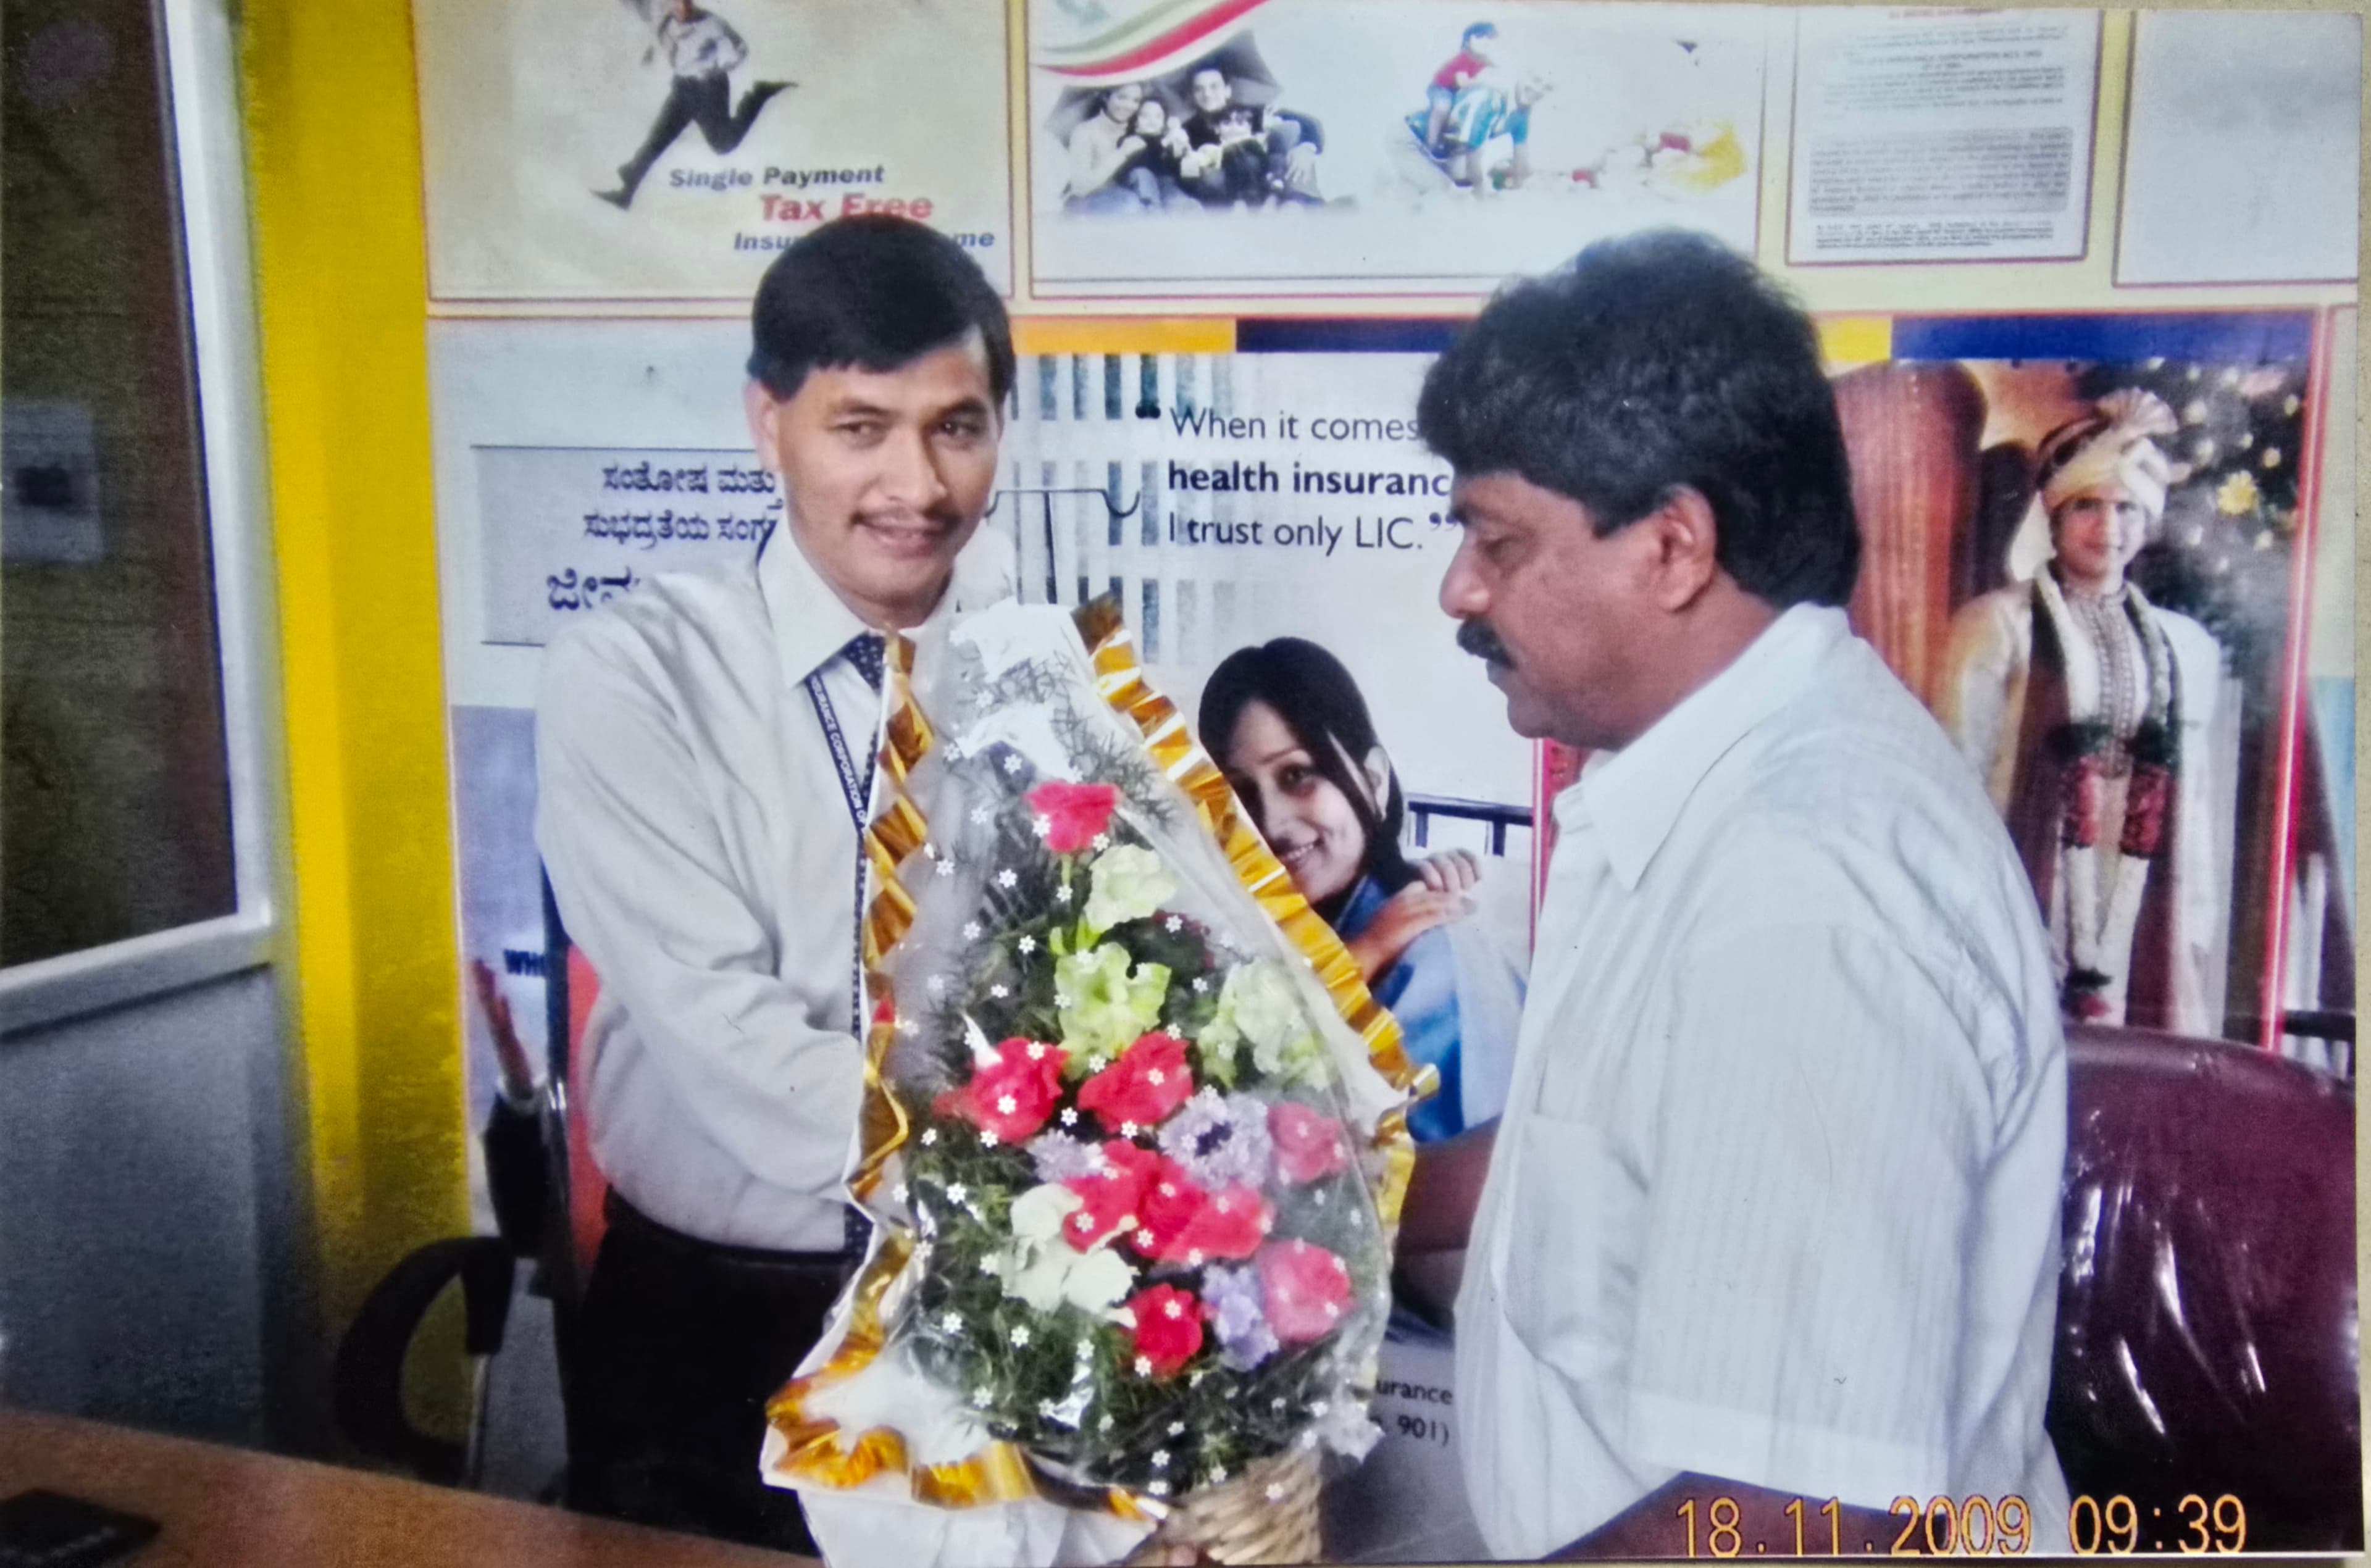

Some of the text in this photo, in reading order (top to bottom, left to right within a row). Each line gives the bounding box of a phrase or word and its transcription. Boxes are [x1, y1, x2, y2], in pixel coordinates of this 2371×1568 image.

[669, 165, 885, 191] Single Payment
[760, 193, 934, 221] Tax Free
[1280, 411, 1299, 440] it
[1311, 416, 1421, 441] comes
[1168, 459, 1450, 496] health insuranc
[1170, 512, 1174, 542] I
[1187, 519, 1263, 544] trust
[1274, 515, 1343, 557] only
[829, 732, 863, 809] CORPORATION
[1375, 1380, 1452, 1405] urance
[1398, 1415, 1449, 1446] 901)
